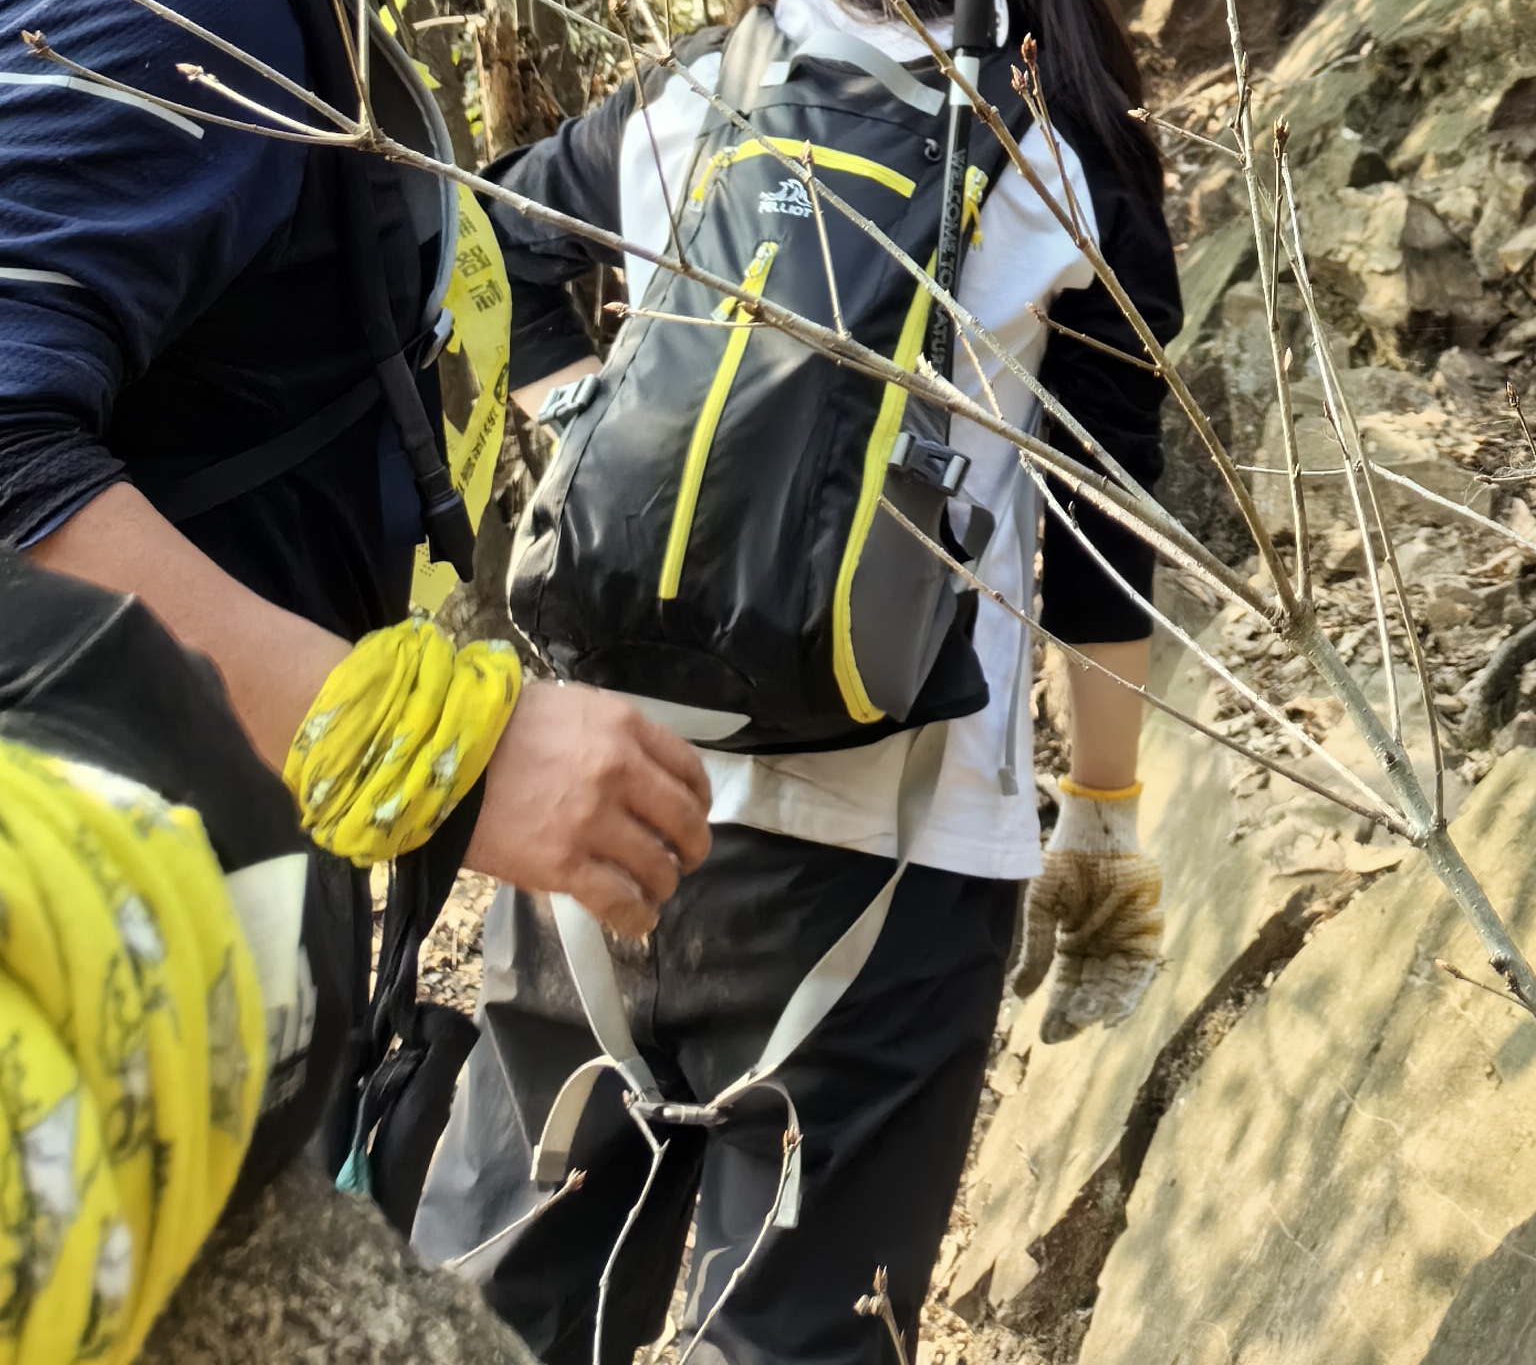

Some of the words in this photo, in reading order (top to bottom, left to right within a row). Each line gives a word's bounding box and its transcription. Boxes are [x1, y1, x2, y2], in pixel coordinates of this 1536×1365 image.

[938, 149, 966, 257] WELCOME
[938, 258, 955, 289] TO
[930, 302, 950, 373] ATUR
